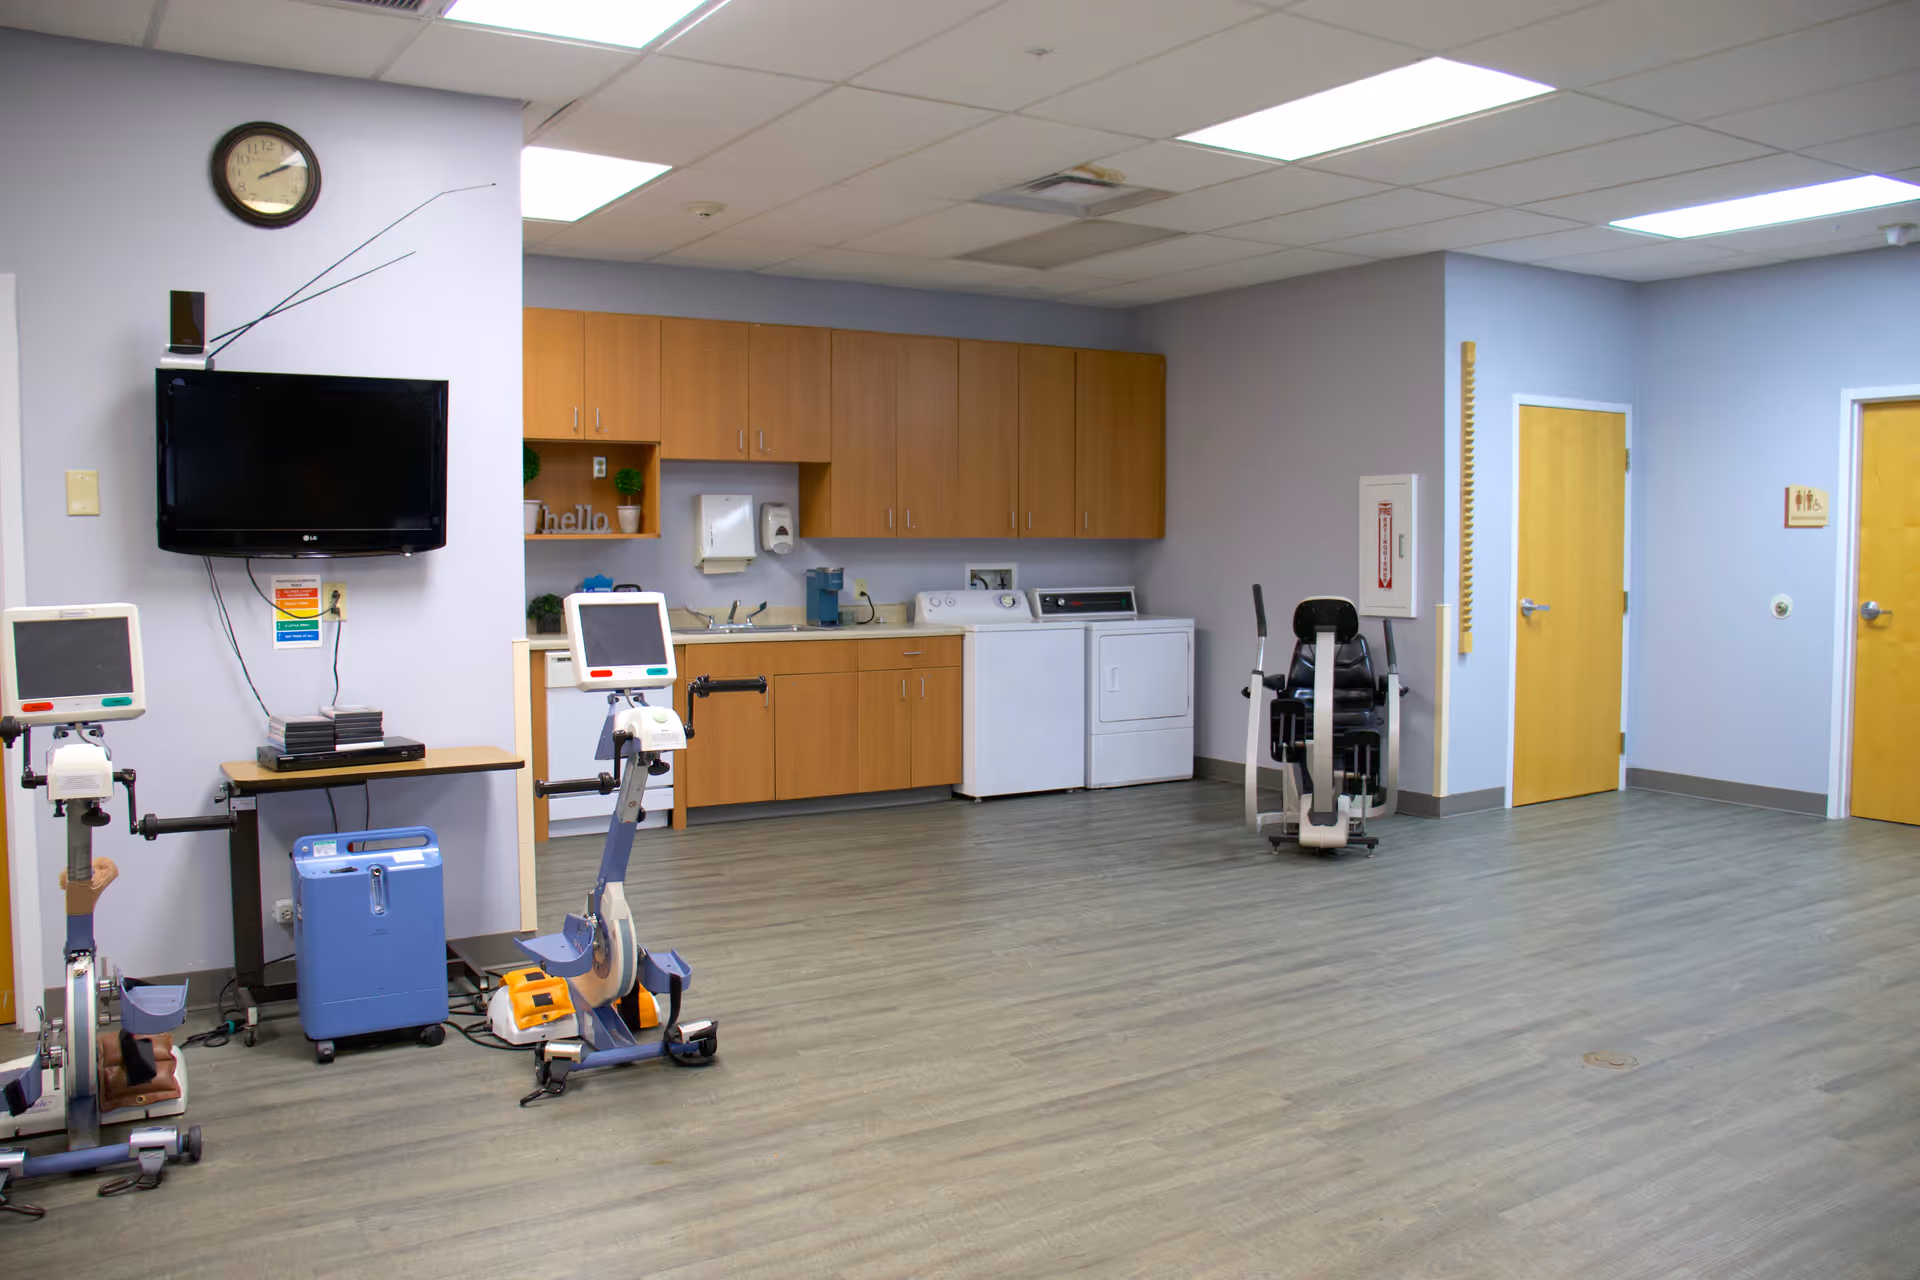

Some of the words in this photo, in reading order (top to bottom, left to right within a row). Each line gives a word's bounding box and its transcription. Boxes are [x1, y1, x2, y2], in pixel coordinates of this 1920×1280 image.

[247, 143, 258, 154] 11
[1379, 508, 1391, 516] FIRE
[540, 504, 611, 533] hello
